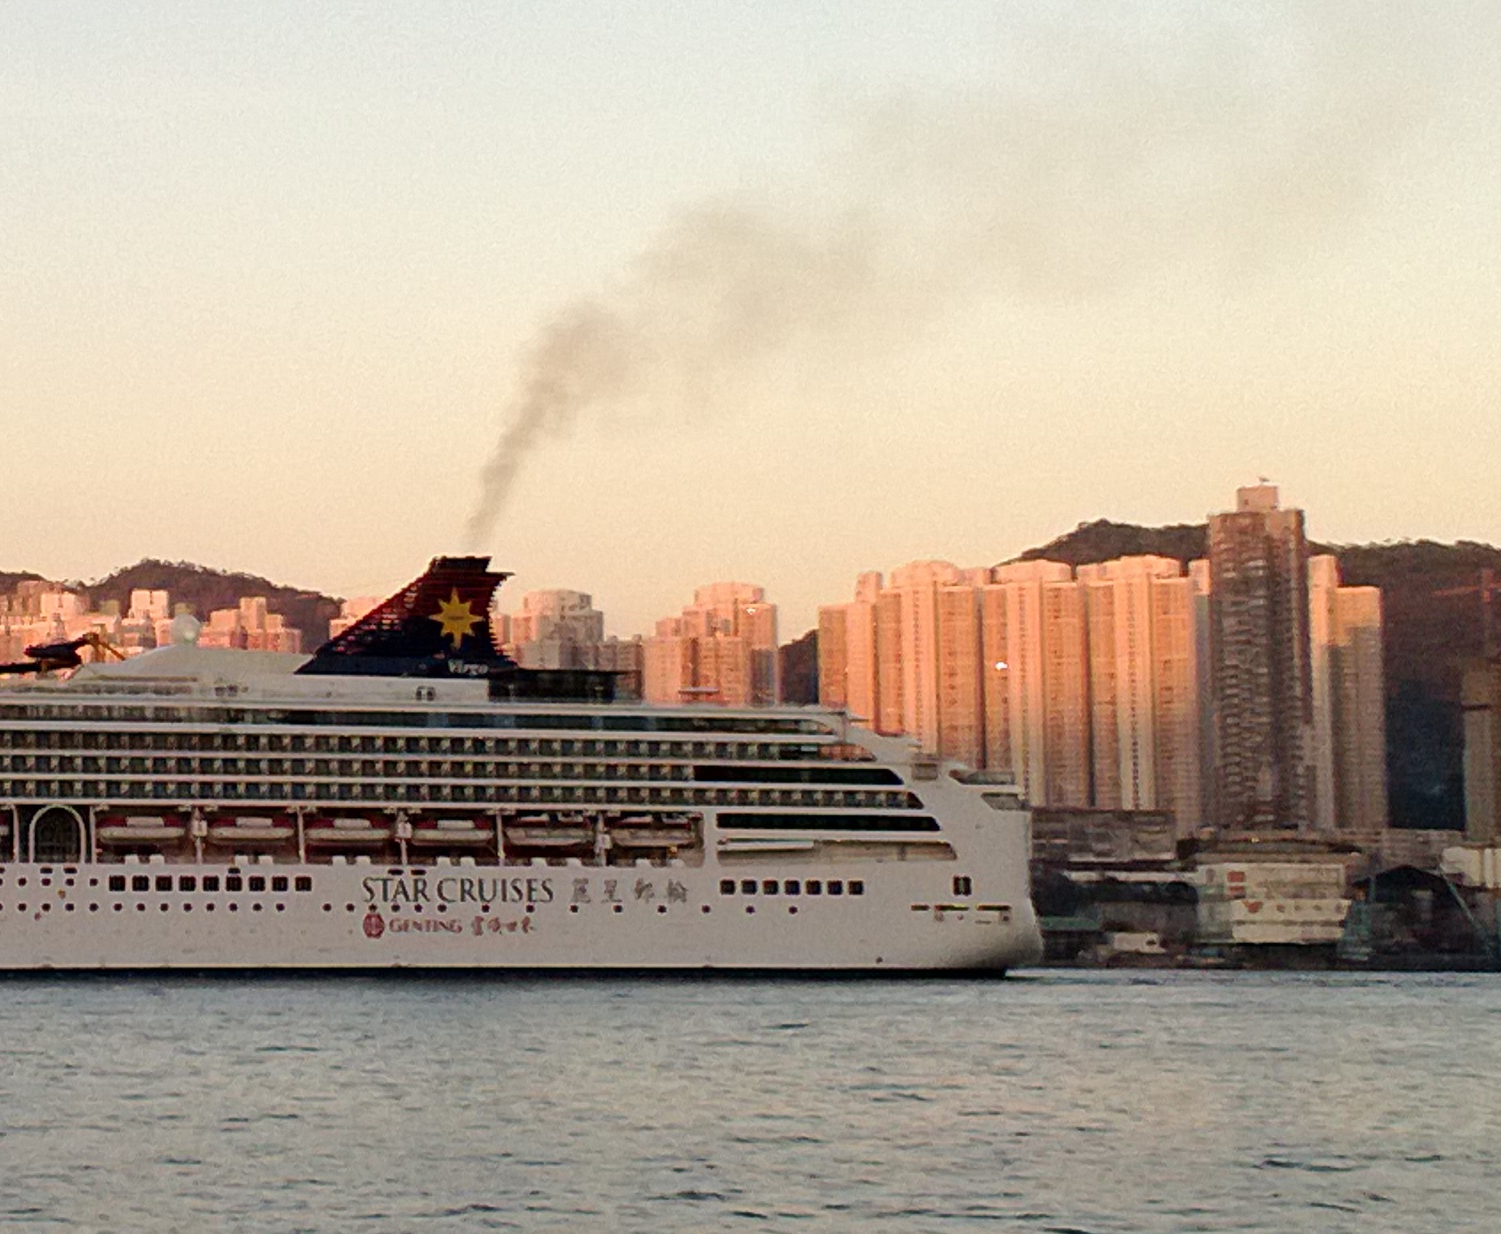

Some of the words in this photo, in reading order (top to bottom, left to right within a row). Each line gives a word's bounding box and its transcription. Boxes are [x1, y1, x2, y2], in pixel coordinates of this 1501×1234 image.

[448, 659, 489, 675] Virgo
[362, 877, 431, 903] STAR
[438, 877, 554, 903] CRUISES
